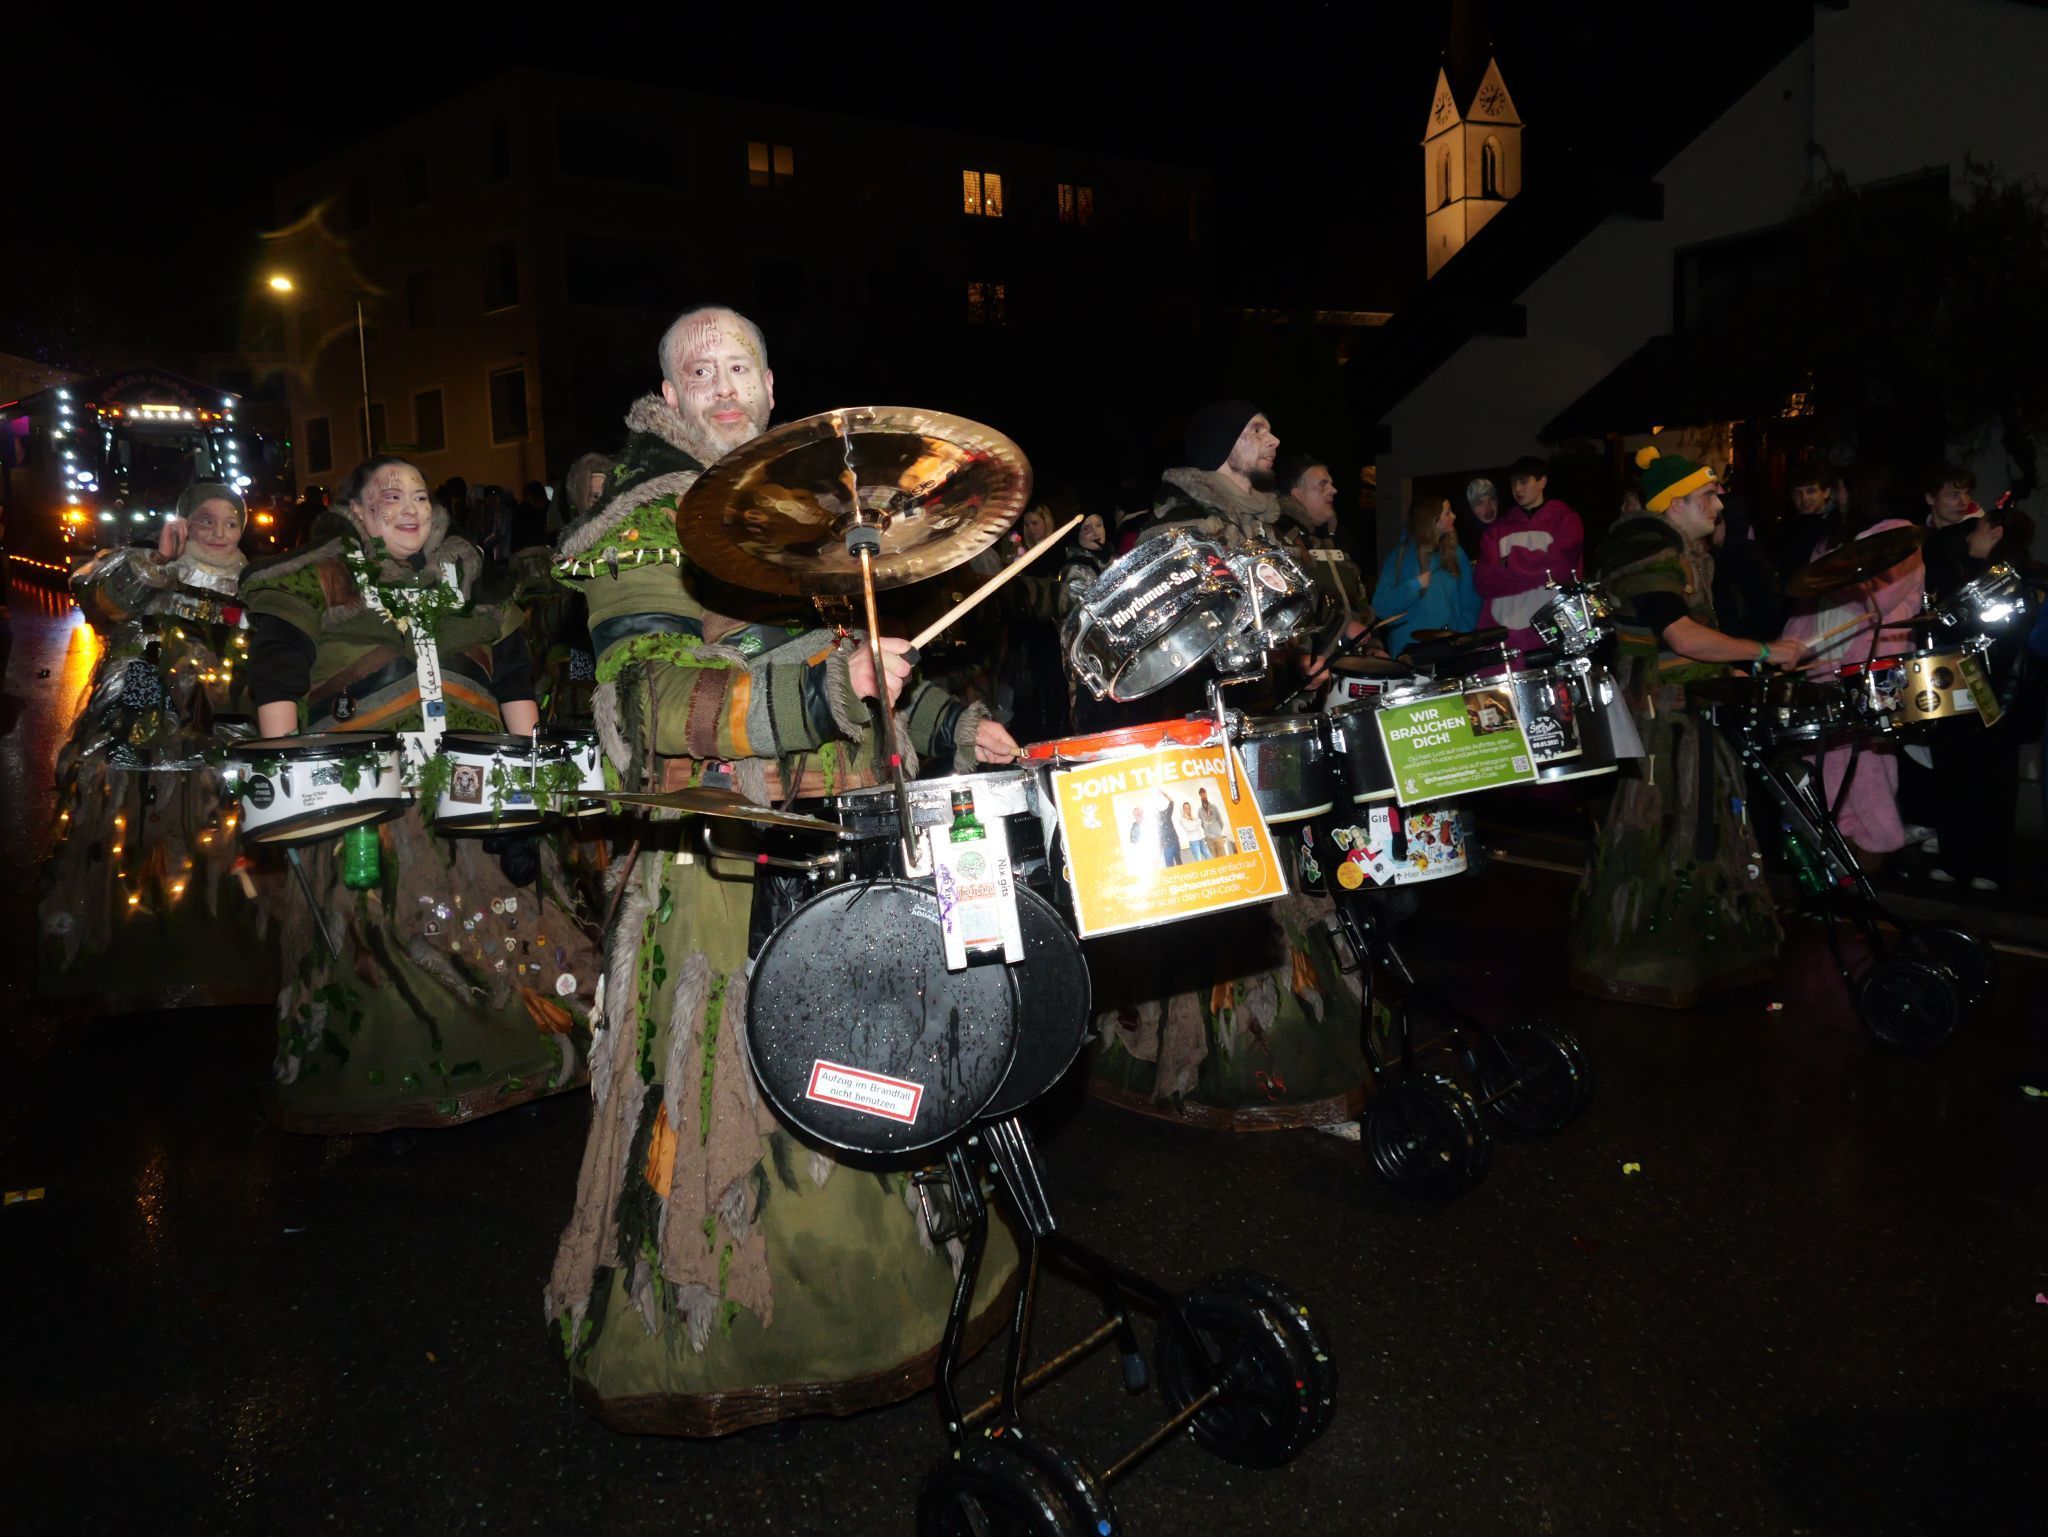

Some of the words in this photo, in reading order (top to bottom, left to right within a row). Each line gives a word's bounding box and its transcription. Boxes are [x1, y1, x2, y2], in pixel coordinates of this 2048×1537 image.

[1111, 567, 1198, 629] Rhythmus-Sau
[1410, 708, 1439, 723] WIR
[1390, 716, 1466, 741] BRAUCHEN
[1412, 732, 1451, 749] DICH!
[1070, 773, 1126, 801] JOIN
[1130, 761, 1179, 787] THE
[1181, 757, 1227, 777] CHAO
[1371, 815, 1388, 823] GIB
[997, 858, 1007, 877] Nix
[1164, 870, 1198, 885] Schreib
[1199, 866, 1217, 877] uns
[1216, 859, 1245, 874] einfach
[1244, 857, 1258, 868] auf
[998, 878, 1009, 898] gits
[1180, 890, 1201, 902] den
[821, 1071, 853, 1088] Aufzug
[855, 1081, 867, 1090] im
[869, 1083, 911, 1101] Brandfall
[830, 1088, 852, 1099] nicht
[854, 1092, 897, 1110] benutzen
